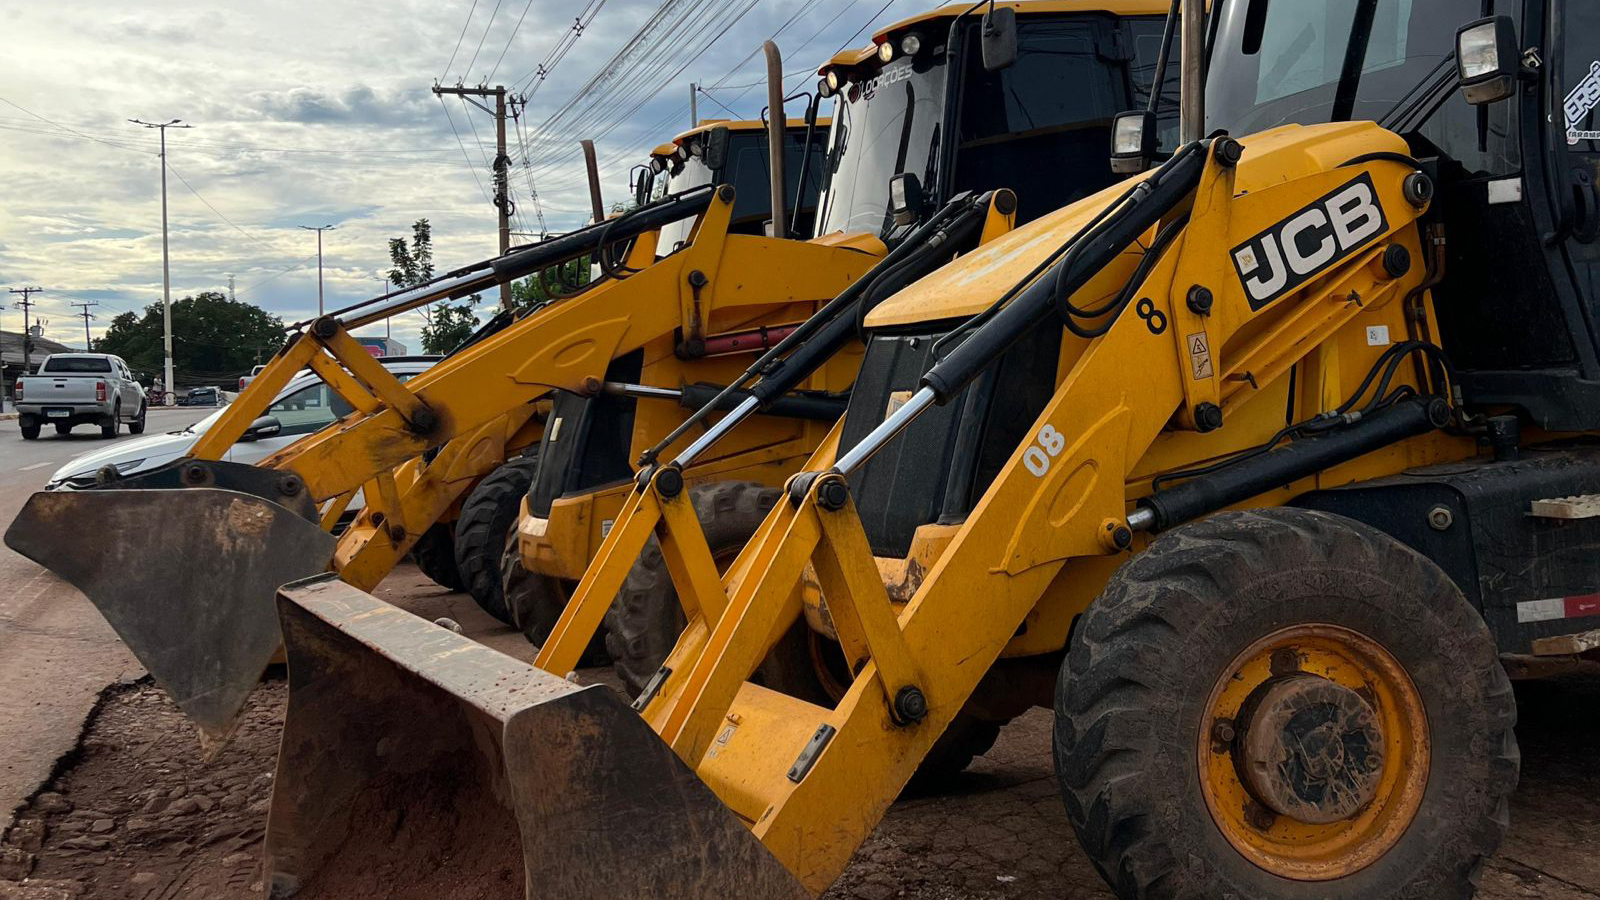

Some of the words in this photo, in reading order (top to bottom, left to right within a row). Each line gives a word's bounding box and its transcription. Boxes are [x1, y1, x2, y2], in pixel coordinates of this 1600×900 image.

[1236, 182, 1382, 301] JCB
[1136, 297, 1167, 335] 8
[1022, 423, 1065, 478] 08
